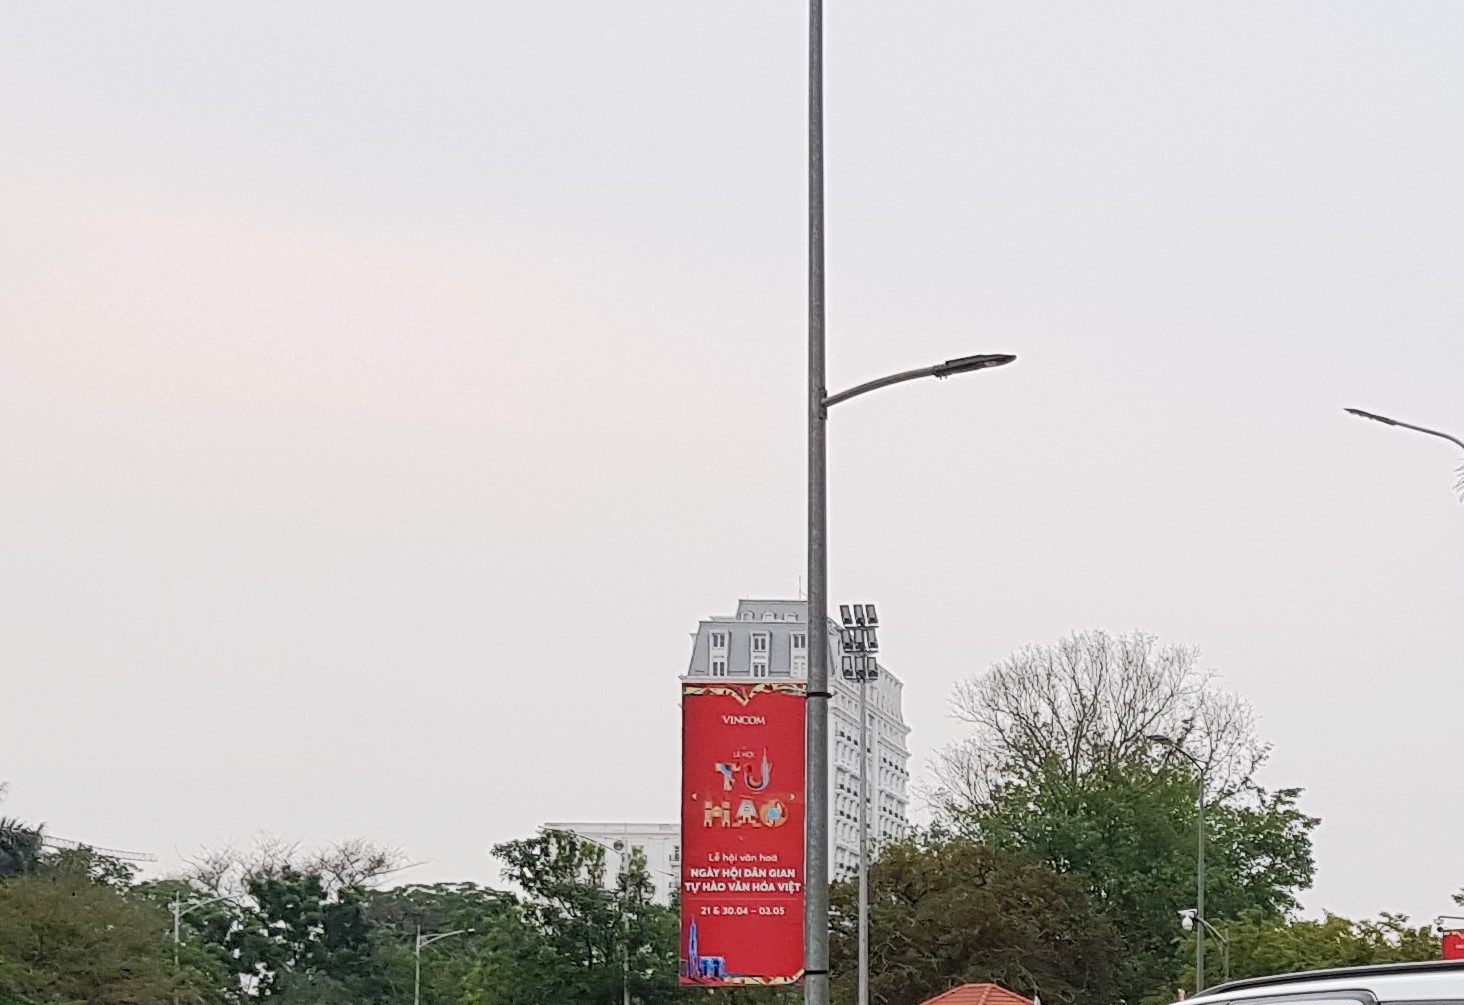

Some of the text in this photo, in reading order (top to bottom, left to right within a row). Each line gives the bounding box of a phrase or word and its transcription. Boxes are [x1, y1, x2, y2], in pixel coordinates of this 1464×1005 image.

[722, 715, 766, 725] VINCOM
[722, 853, 738, 864] hội
[690, 866, 796, 880] NGÀY HỘI DÂN GIAN
[684, 880, 801, 895] TỰ HÀO VĂN HÓA VIỆT
[700, 906, 711, 916] 21
[712, 906, 720, 916] &
[721, 906, 749, 916] 30.04
